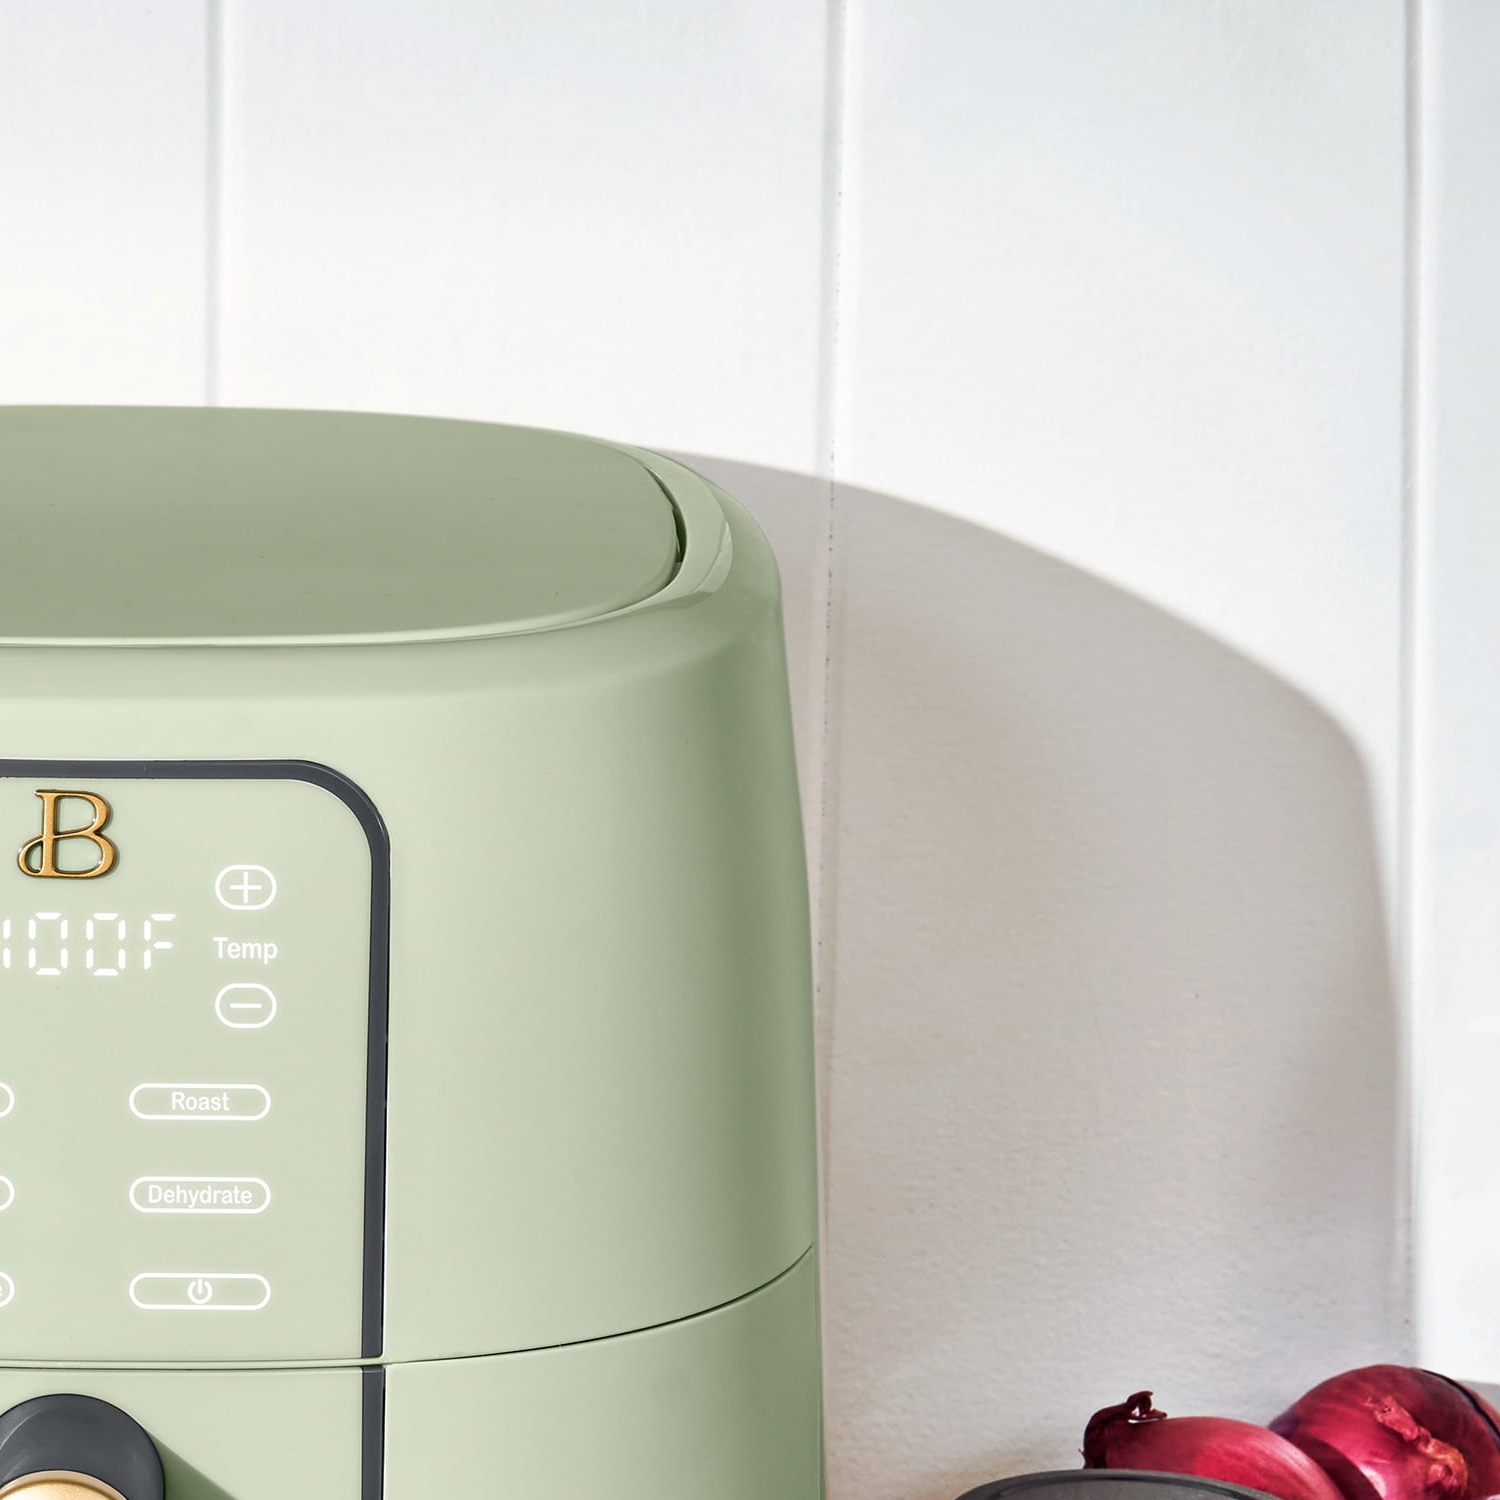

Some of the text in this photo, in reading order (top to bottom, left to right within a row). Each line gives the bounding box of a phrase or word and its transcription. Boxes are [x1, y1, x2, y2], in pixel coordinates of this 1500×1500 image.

[17, 789, 118, 878] B
[213, 936, 278, 963] Temp
[171, 1091, 230, 1112] Roast
[147, 1184, 253, 1208] Dehydrate
